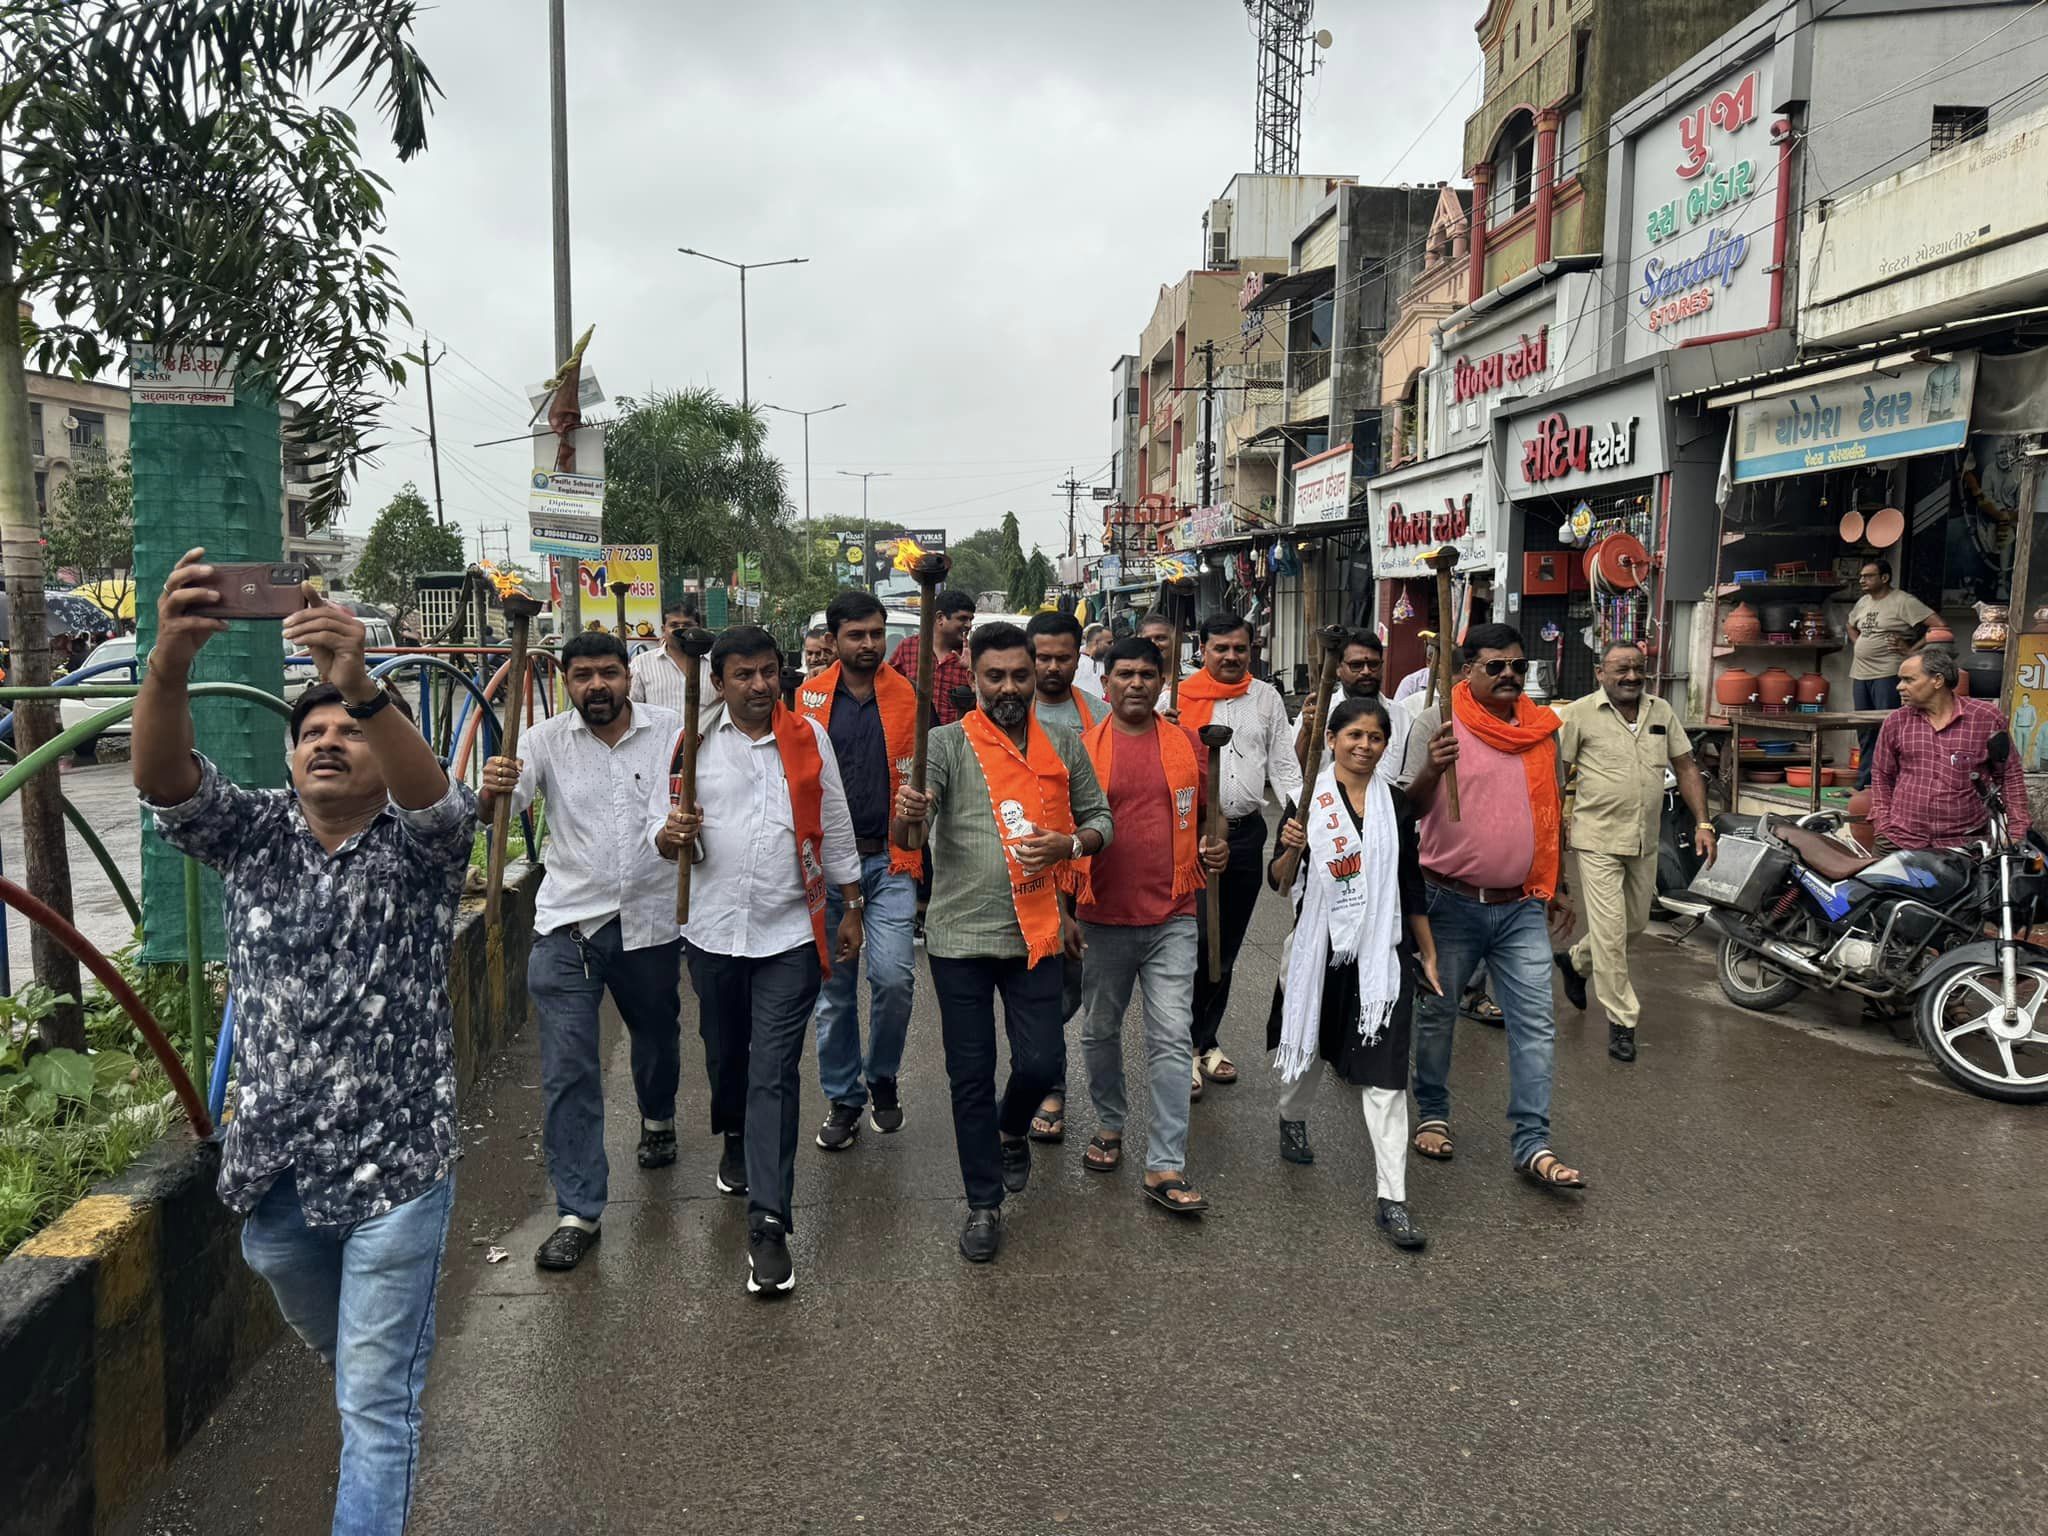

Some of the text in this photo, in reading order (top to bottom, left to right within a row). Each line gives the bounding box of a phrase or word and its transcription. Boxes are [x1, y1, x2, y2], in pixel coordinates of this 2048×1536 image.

[1675, 70, 1760, 180] પુજા
[1646, 160, 1756, 243] રસ ભંડાર
[1639, 227, 1751, 306] Sandip
[1649, 288, 1714, 332] STORES
[1454, 355, 1503, 404] વિનય
[1776, 386, 1913, 446] યોગેશ ટેલર
[1521, 412, 1639, 484] સંદિપ સ્ટોર્સ
[549, 499, 583, 508] Diploma
[550, 478, 571, 486] Pacific
[573, 480, 594, 488] School
[558, 487, 595, 496] Engineering
[1388, 502, 1431, 548] વિનય
[617, 547, 653, 561] 72399
